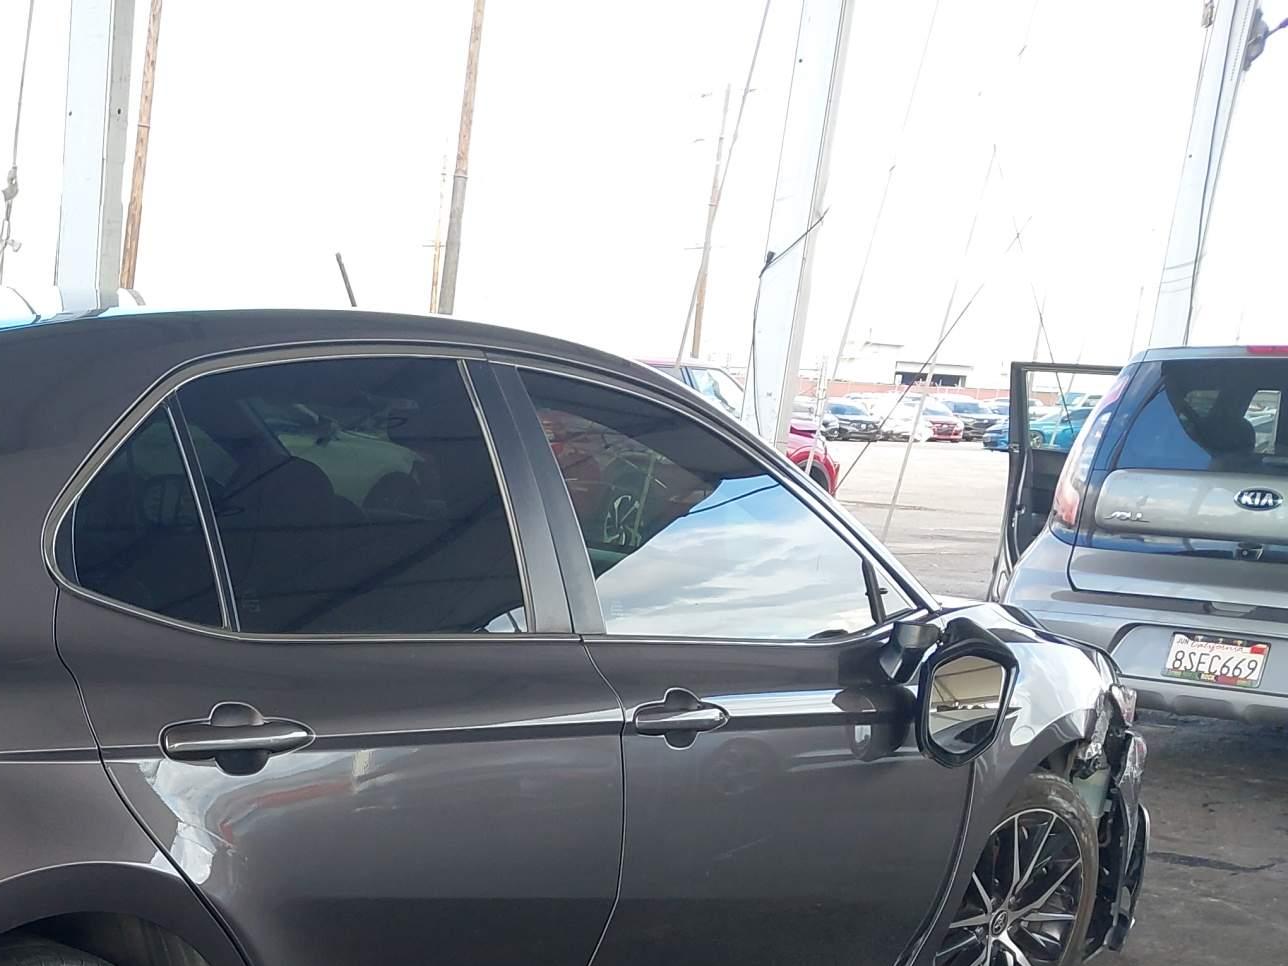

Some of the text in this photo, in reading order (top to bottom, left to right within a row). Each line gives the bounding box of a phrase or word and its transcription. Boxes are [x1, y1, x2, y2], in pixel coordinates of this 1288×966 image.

[1241, 491, 1274, 506] KIA
[1191, 640, 1244, 653] California
[1172, 650, 1258, 680] 8SEC669
